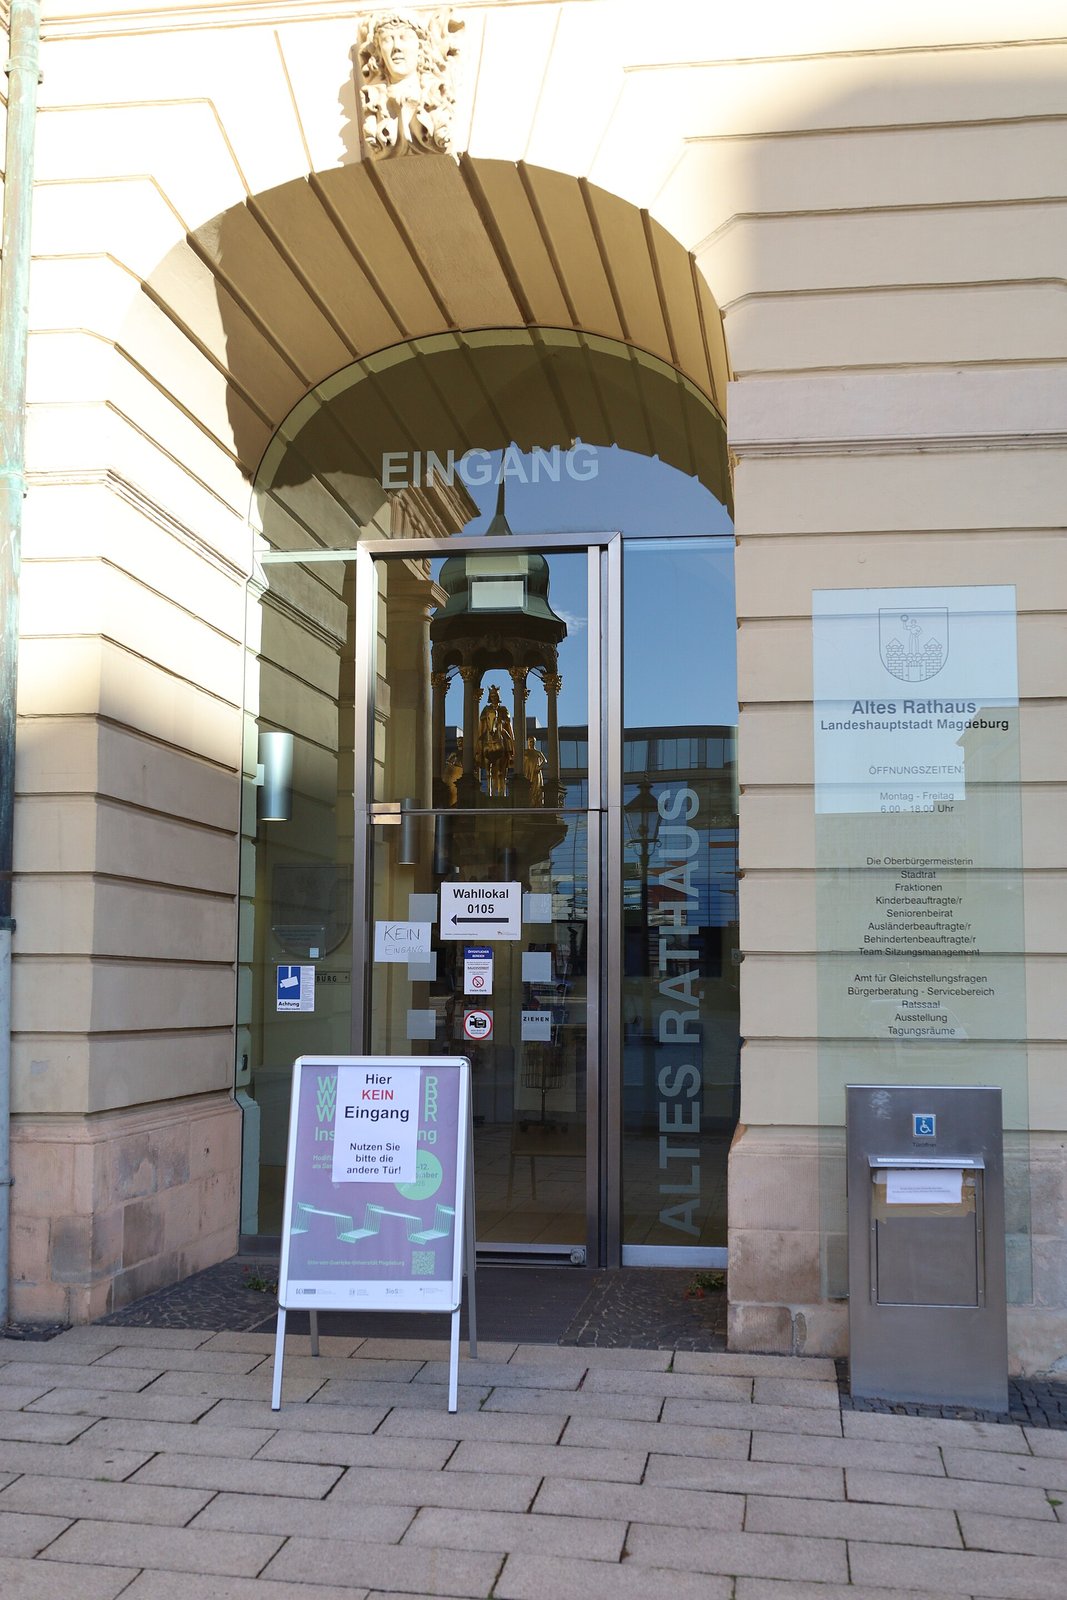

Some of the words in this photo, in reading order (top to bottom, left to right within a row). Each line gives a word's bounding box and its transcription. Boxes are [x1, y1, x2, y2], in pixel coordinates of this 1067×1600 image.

[382, 443, 599, 489] EINGANG
[852, 700, 897, 715] Altes
[903, 699, 977, 714] Rathaus
[820, 720, 933, 732] Landeshauptstadt
[937, 719, 1009, 731] Magdeburg
[880, 792, 914, 802] Montag
[922, 792, 955, 802] Freitag
[880, 805, 901, 814] 6.00
[910, 805, 935, 813] 18.00
[937, 804, 955, 813] Uhr
[866, 857, 882, 866] Die
[883, 857, 974, 867] Oberbürgermeisterin
[900, 870, 936, 879] Stadtrat
[895, 883, 943, 892] Fraktionen
[453, 888, 509, 899] Wahllokal
[876, 896, 962, 906] Kinderbeauftragte/r
[467, 903, 495, 914] 0105
[886, 909, 953, 918] Seniorenbeirat
[658, 788, 700, 1043] RATHAUS
[868, 922, 971, 932] Ausländerbeauftragte/r
[383, 924, 421, 942] KEIN
[863, 935, 976, 945] Behindertenbeauftragte/r
[859, 947, 883, 956] Team
[884, 947, 980, 958] Sitzungsmanagement
[854, 974, 873, 983] Amt
[874, 973, 887, 983] für
[888, 973, 988, 984] Gleichstellungsfragen
[847, 986, 919, 997] Bürgerberatung
[927, 986, 995, 996] Servicebereich
[902, 1000, 941, 1009] Ratssaal
[895, 1013, 948, 1023] Ausstellung
[888, 1026, 956, 1036] Tagungsräume
[365, 1073, 392, 1085] Hier
[362, 1089, 394, 1100] KEIN
[344, 1105, 410, 1122] Eingang
[349, 1142, 383, 1151] Nutzen
[385, 1142, 401, 1151] Sie
[658, 1065, 700, 1236] ALTES
[355, 1154, 377, 1163] bitte
[379, 1154, 394, 1163] die
[346, 1166, 380, 1174] andere
[382, 1165, 402, 1174] Tür!
